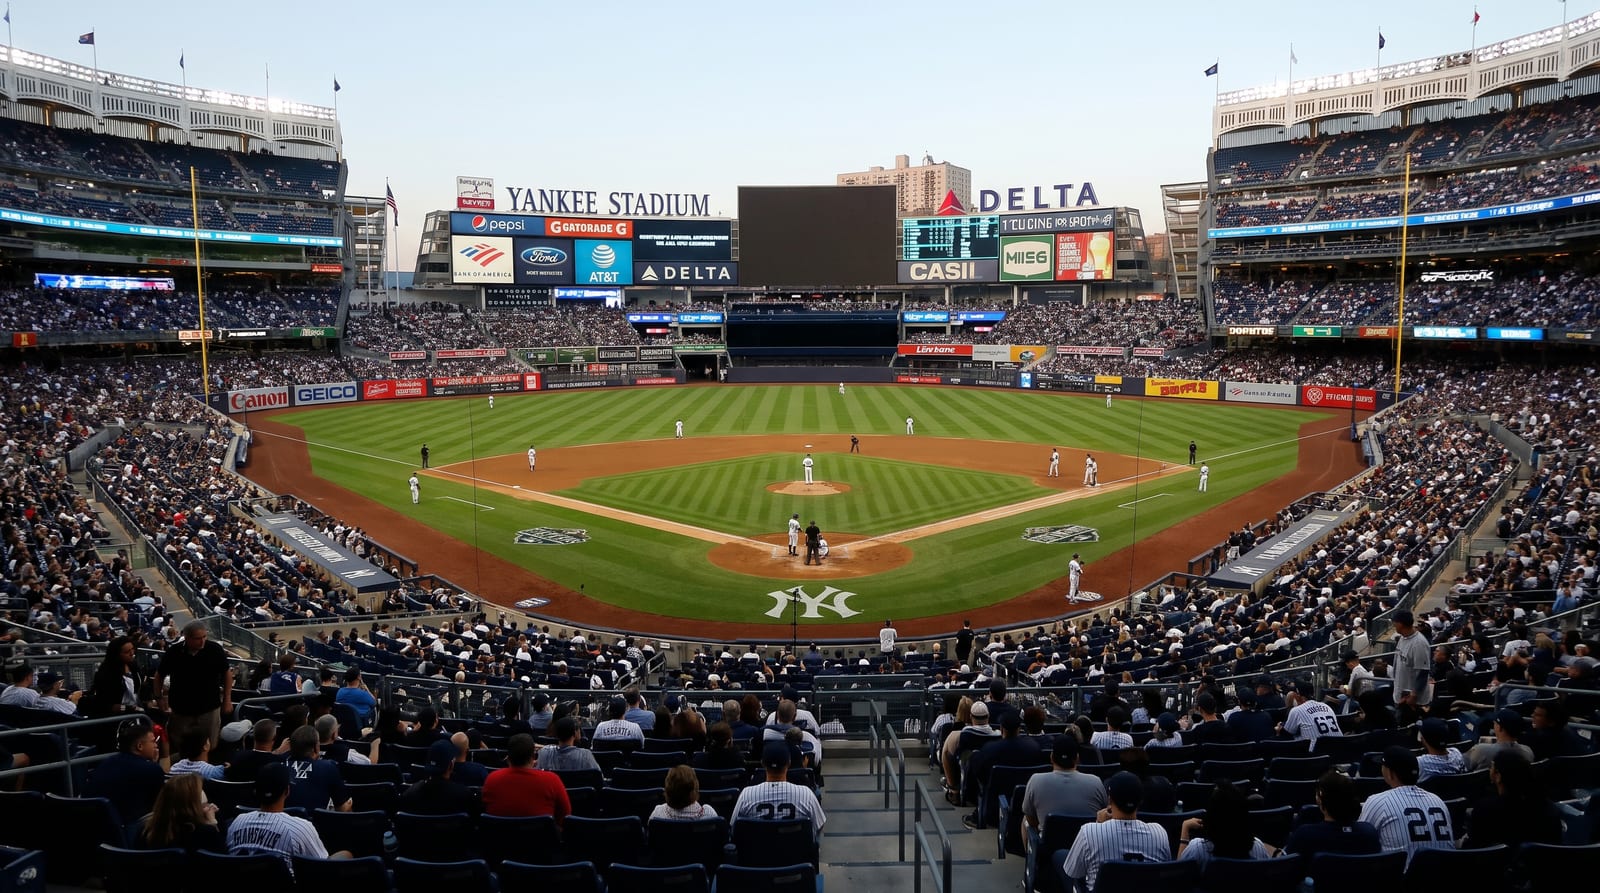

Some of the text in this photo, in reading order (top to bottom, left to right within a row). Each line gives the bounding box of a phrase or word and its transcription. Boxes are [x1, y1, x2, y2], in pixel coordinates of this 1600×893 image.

[506, 187, 710, 216] YANKEE STADIUM
[980, 182, 1099, 212] DELTA
[489, 219, 525, 233] pepsi
[562, 222, 613, 233] GATORADE
[530, 249, 558, 263] Ford
[589, 272, 620, 282] AT&T
[664, 266, 731, 280] DELTA
[231, 391, 289, 410] Canon
[298, 385, 356, 402] GEICO
[1314, 715, 1340, 735] 63
[1403, 806, 1451, 842] 22
